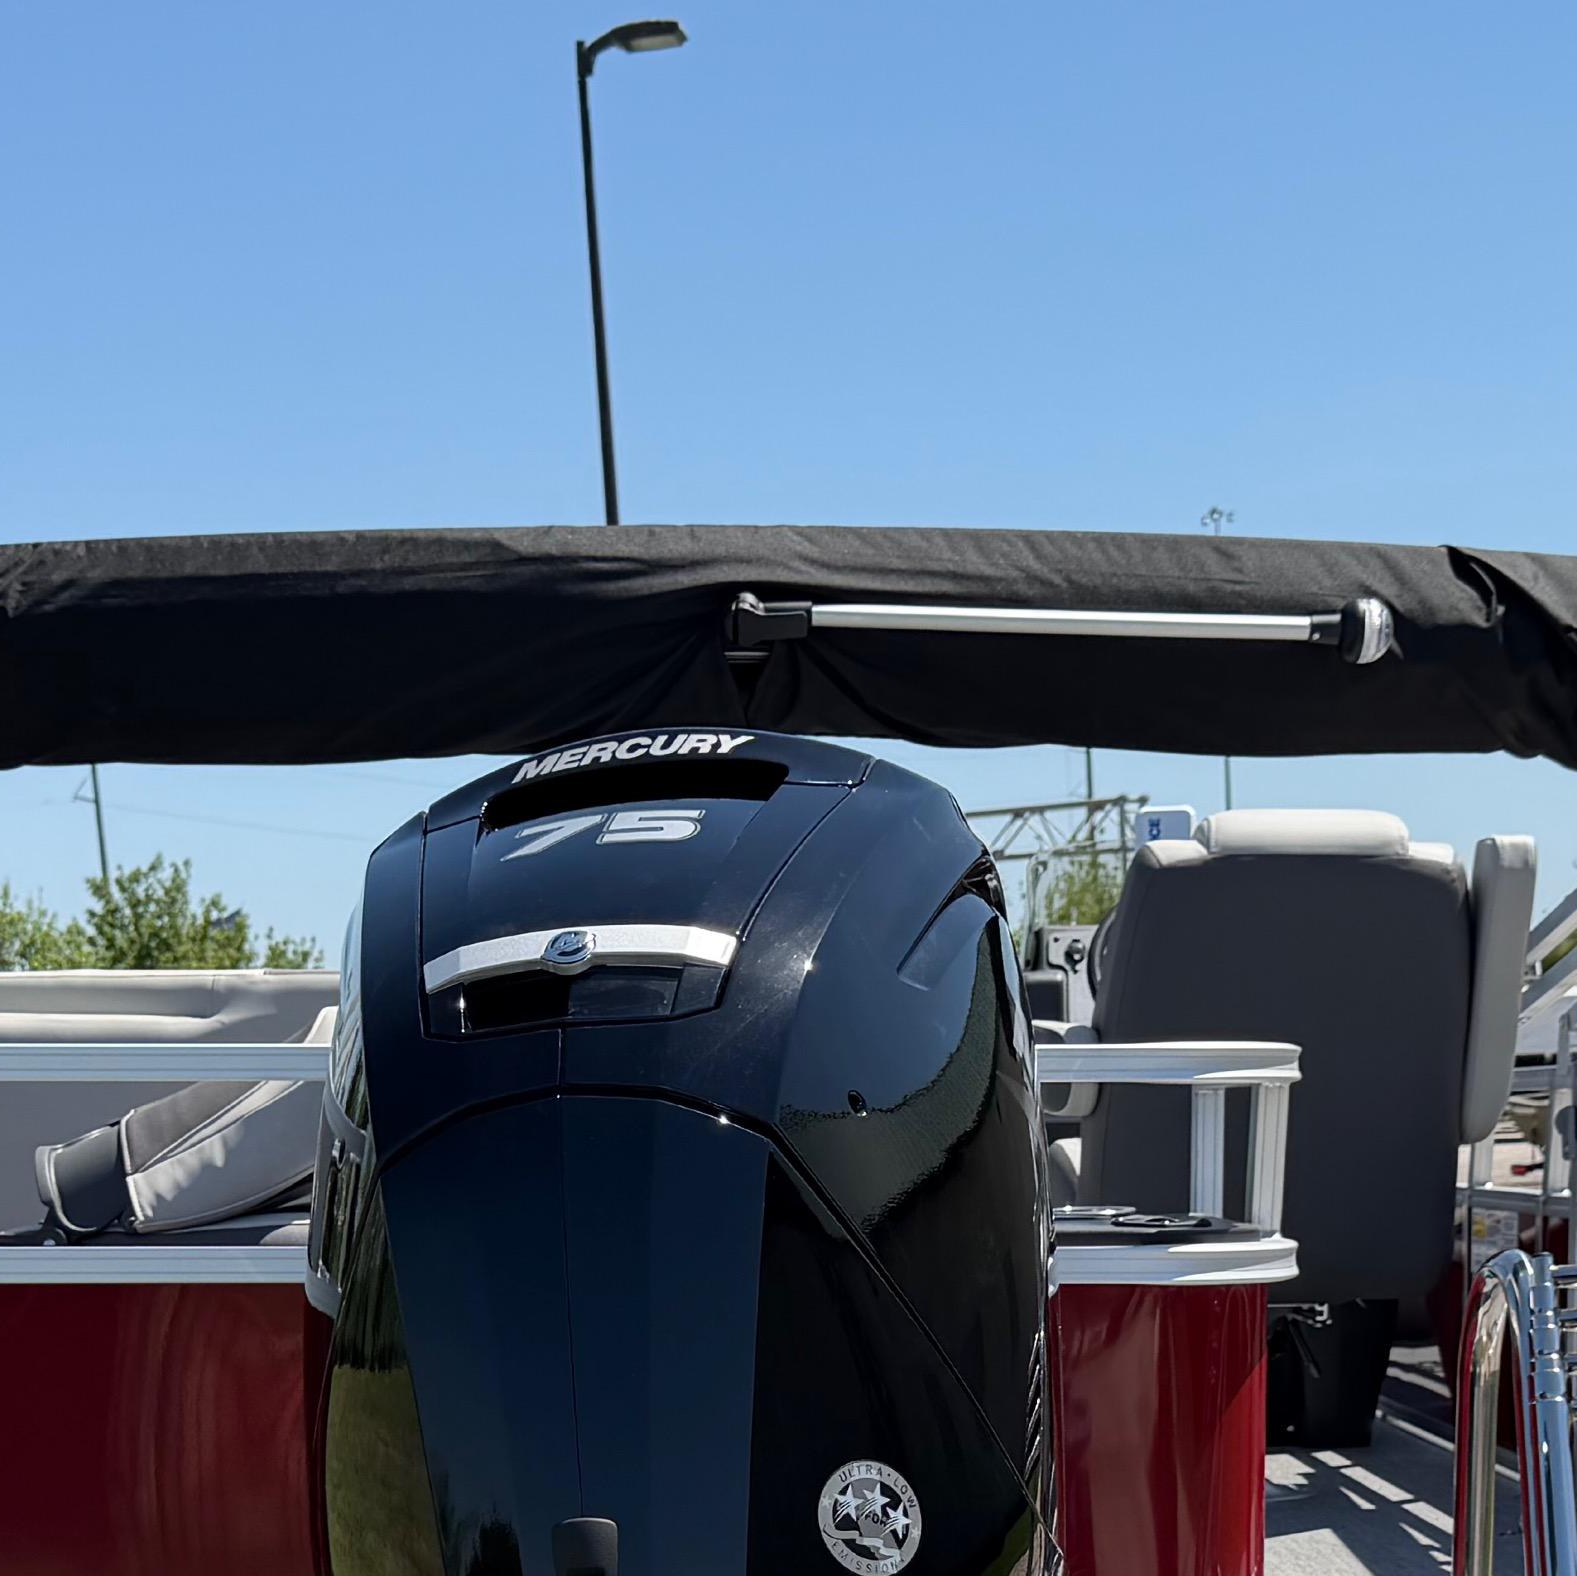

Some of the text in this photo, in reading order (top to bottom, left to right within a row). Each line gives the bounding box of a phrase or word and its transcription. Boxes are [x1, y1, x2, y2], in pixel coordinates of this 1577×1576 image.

[511, 733, 755, 784] MERCURY
[500, 810, 706, 861] 75
[839, 1464, 918, 1509] ULTRA LOW
